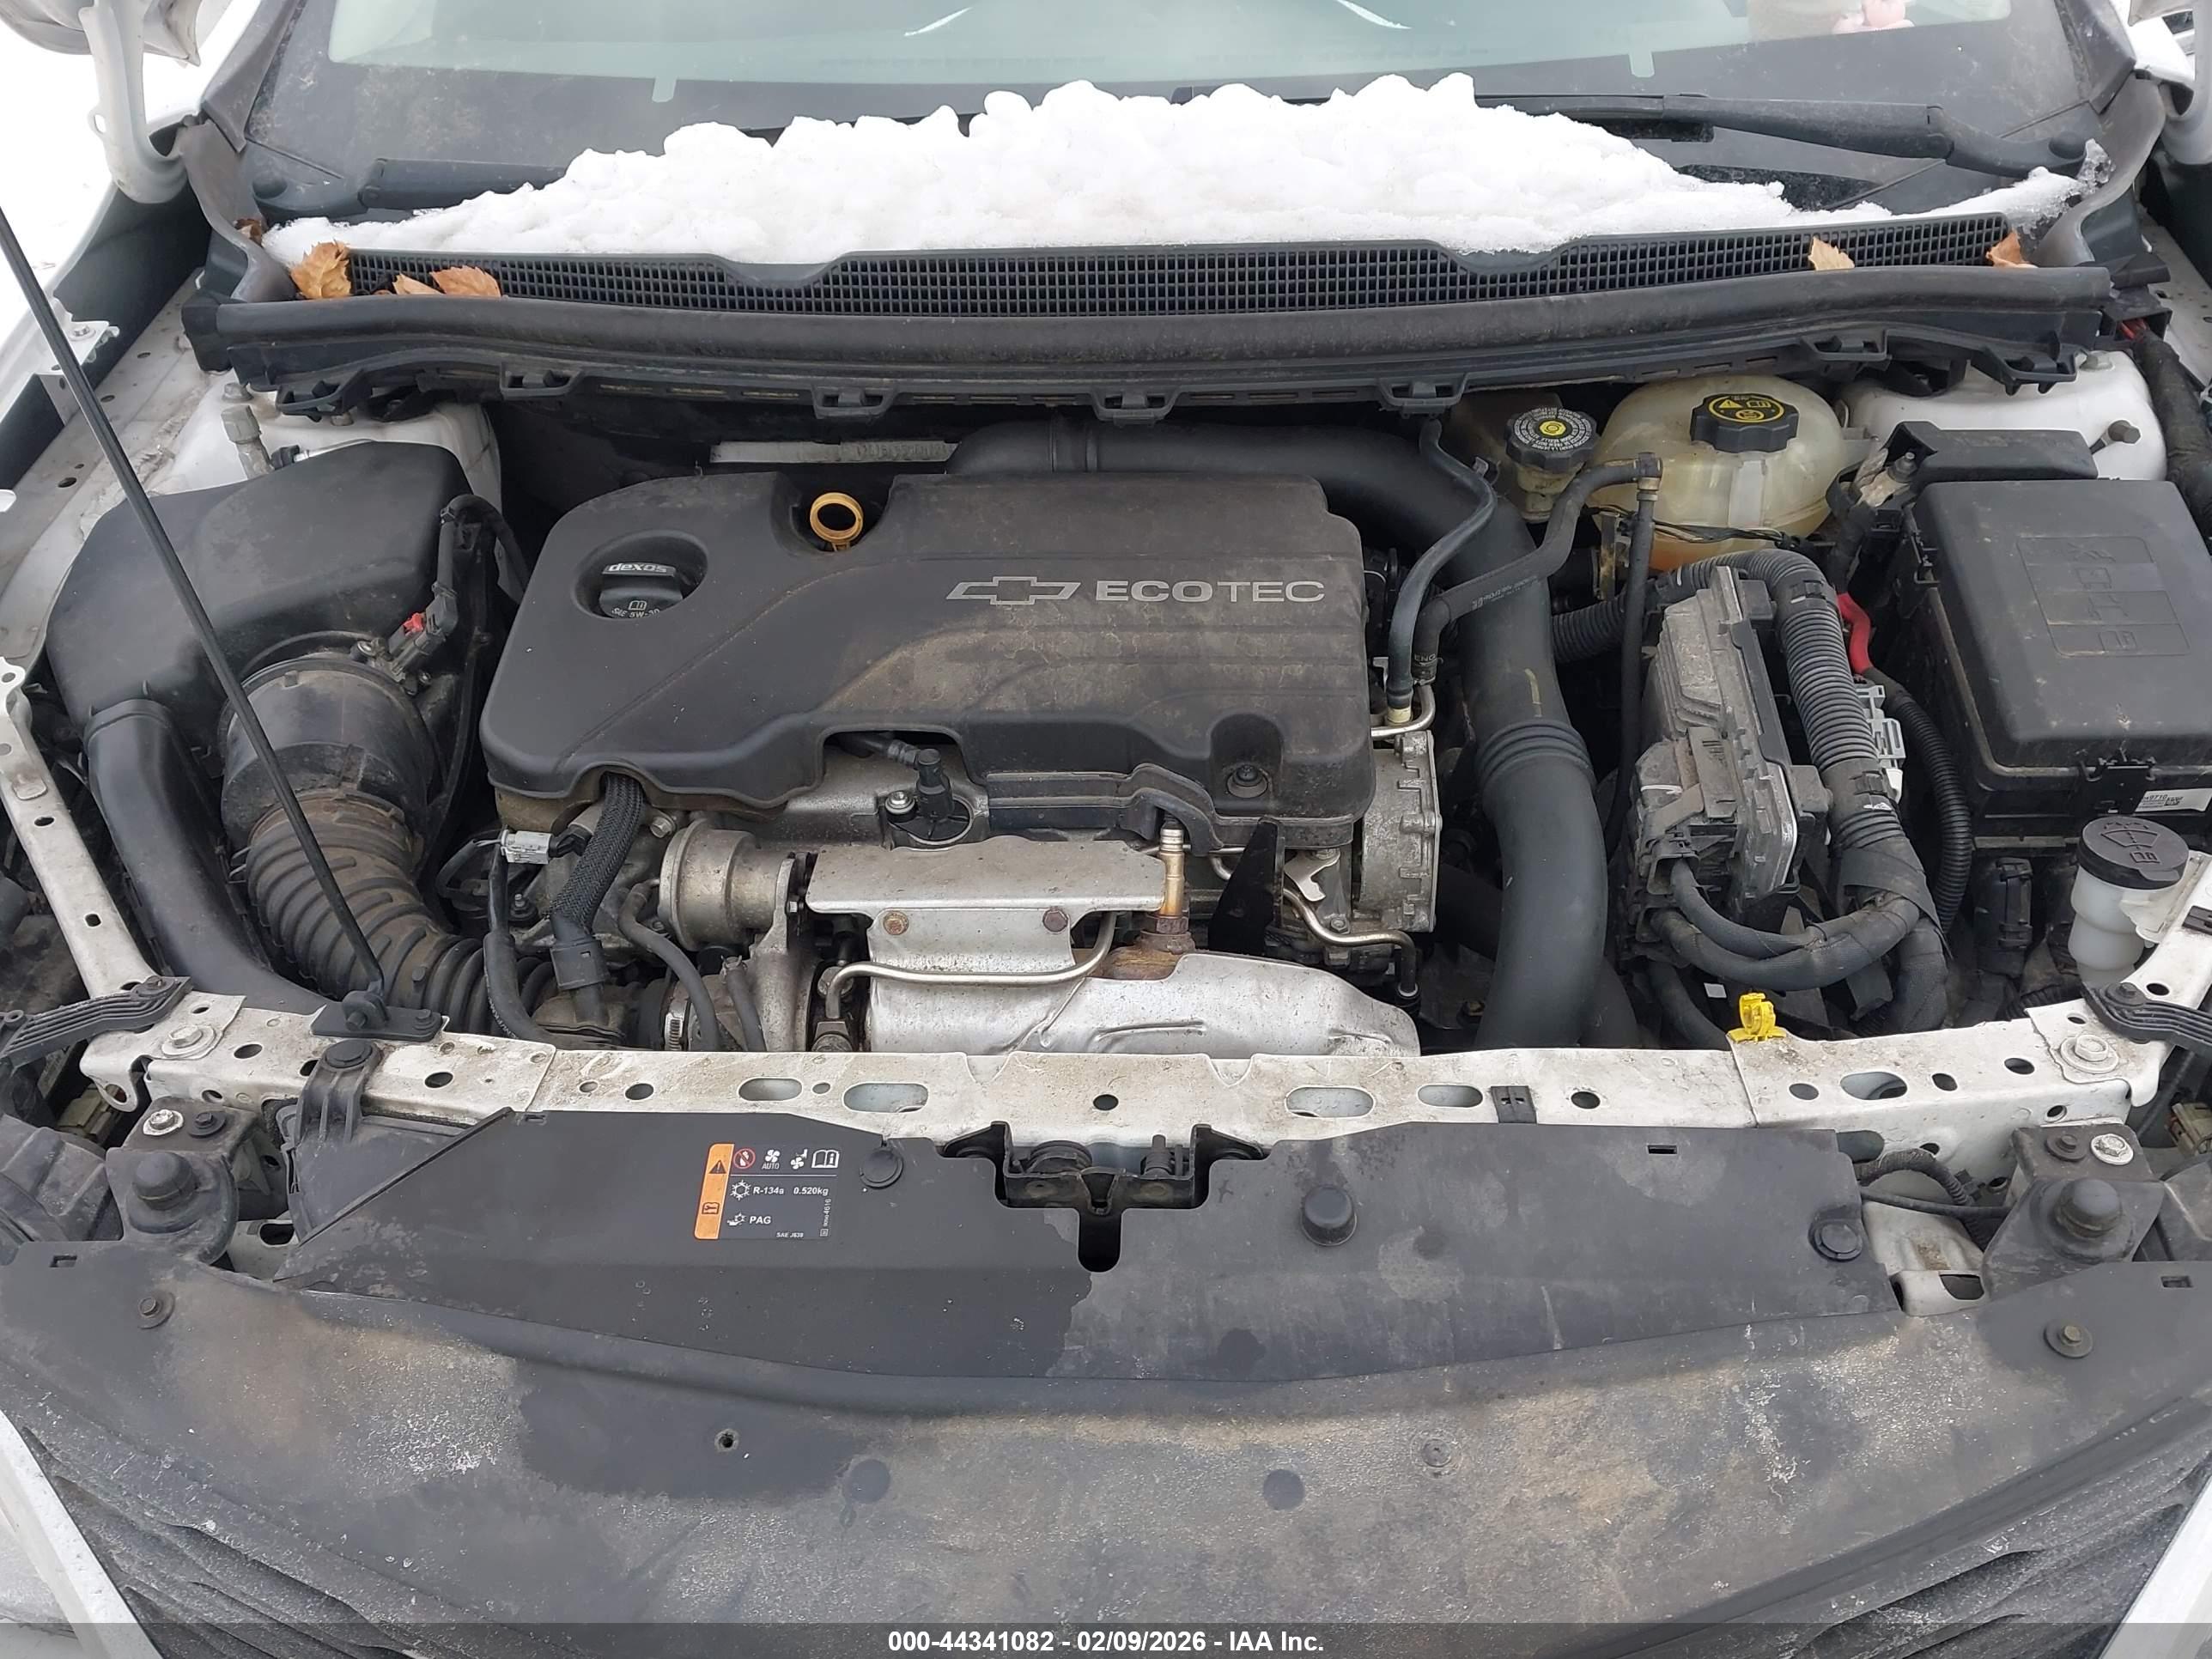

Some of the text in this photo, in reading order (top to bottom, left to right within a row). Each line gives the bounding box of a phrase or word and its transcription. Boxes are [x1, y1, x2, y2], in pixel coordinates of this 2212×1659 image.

[608, 562, 668, 574] dexos
[1096, 580, 1325, 602] ECOTEC
[752, 1186, 830, 1196] R-134a 0.520kg
[749, 1215, 772, 1224] PAG
